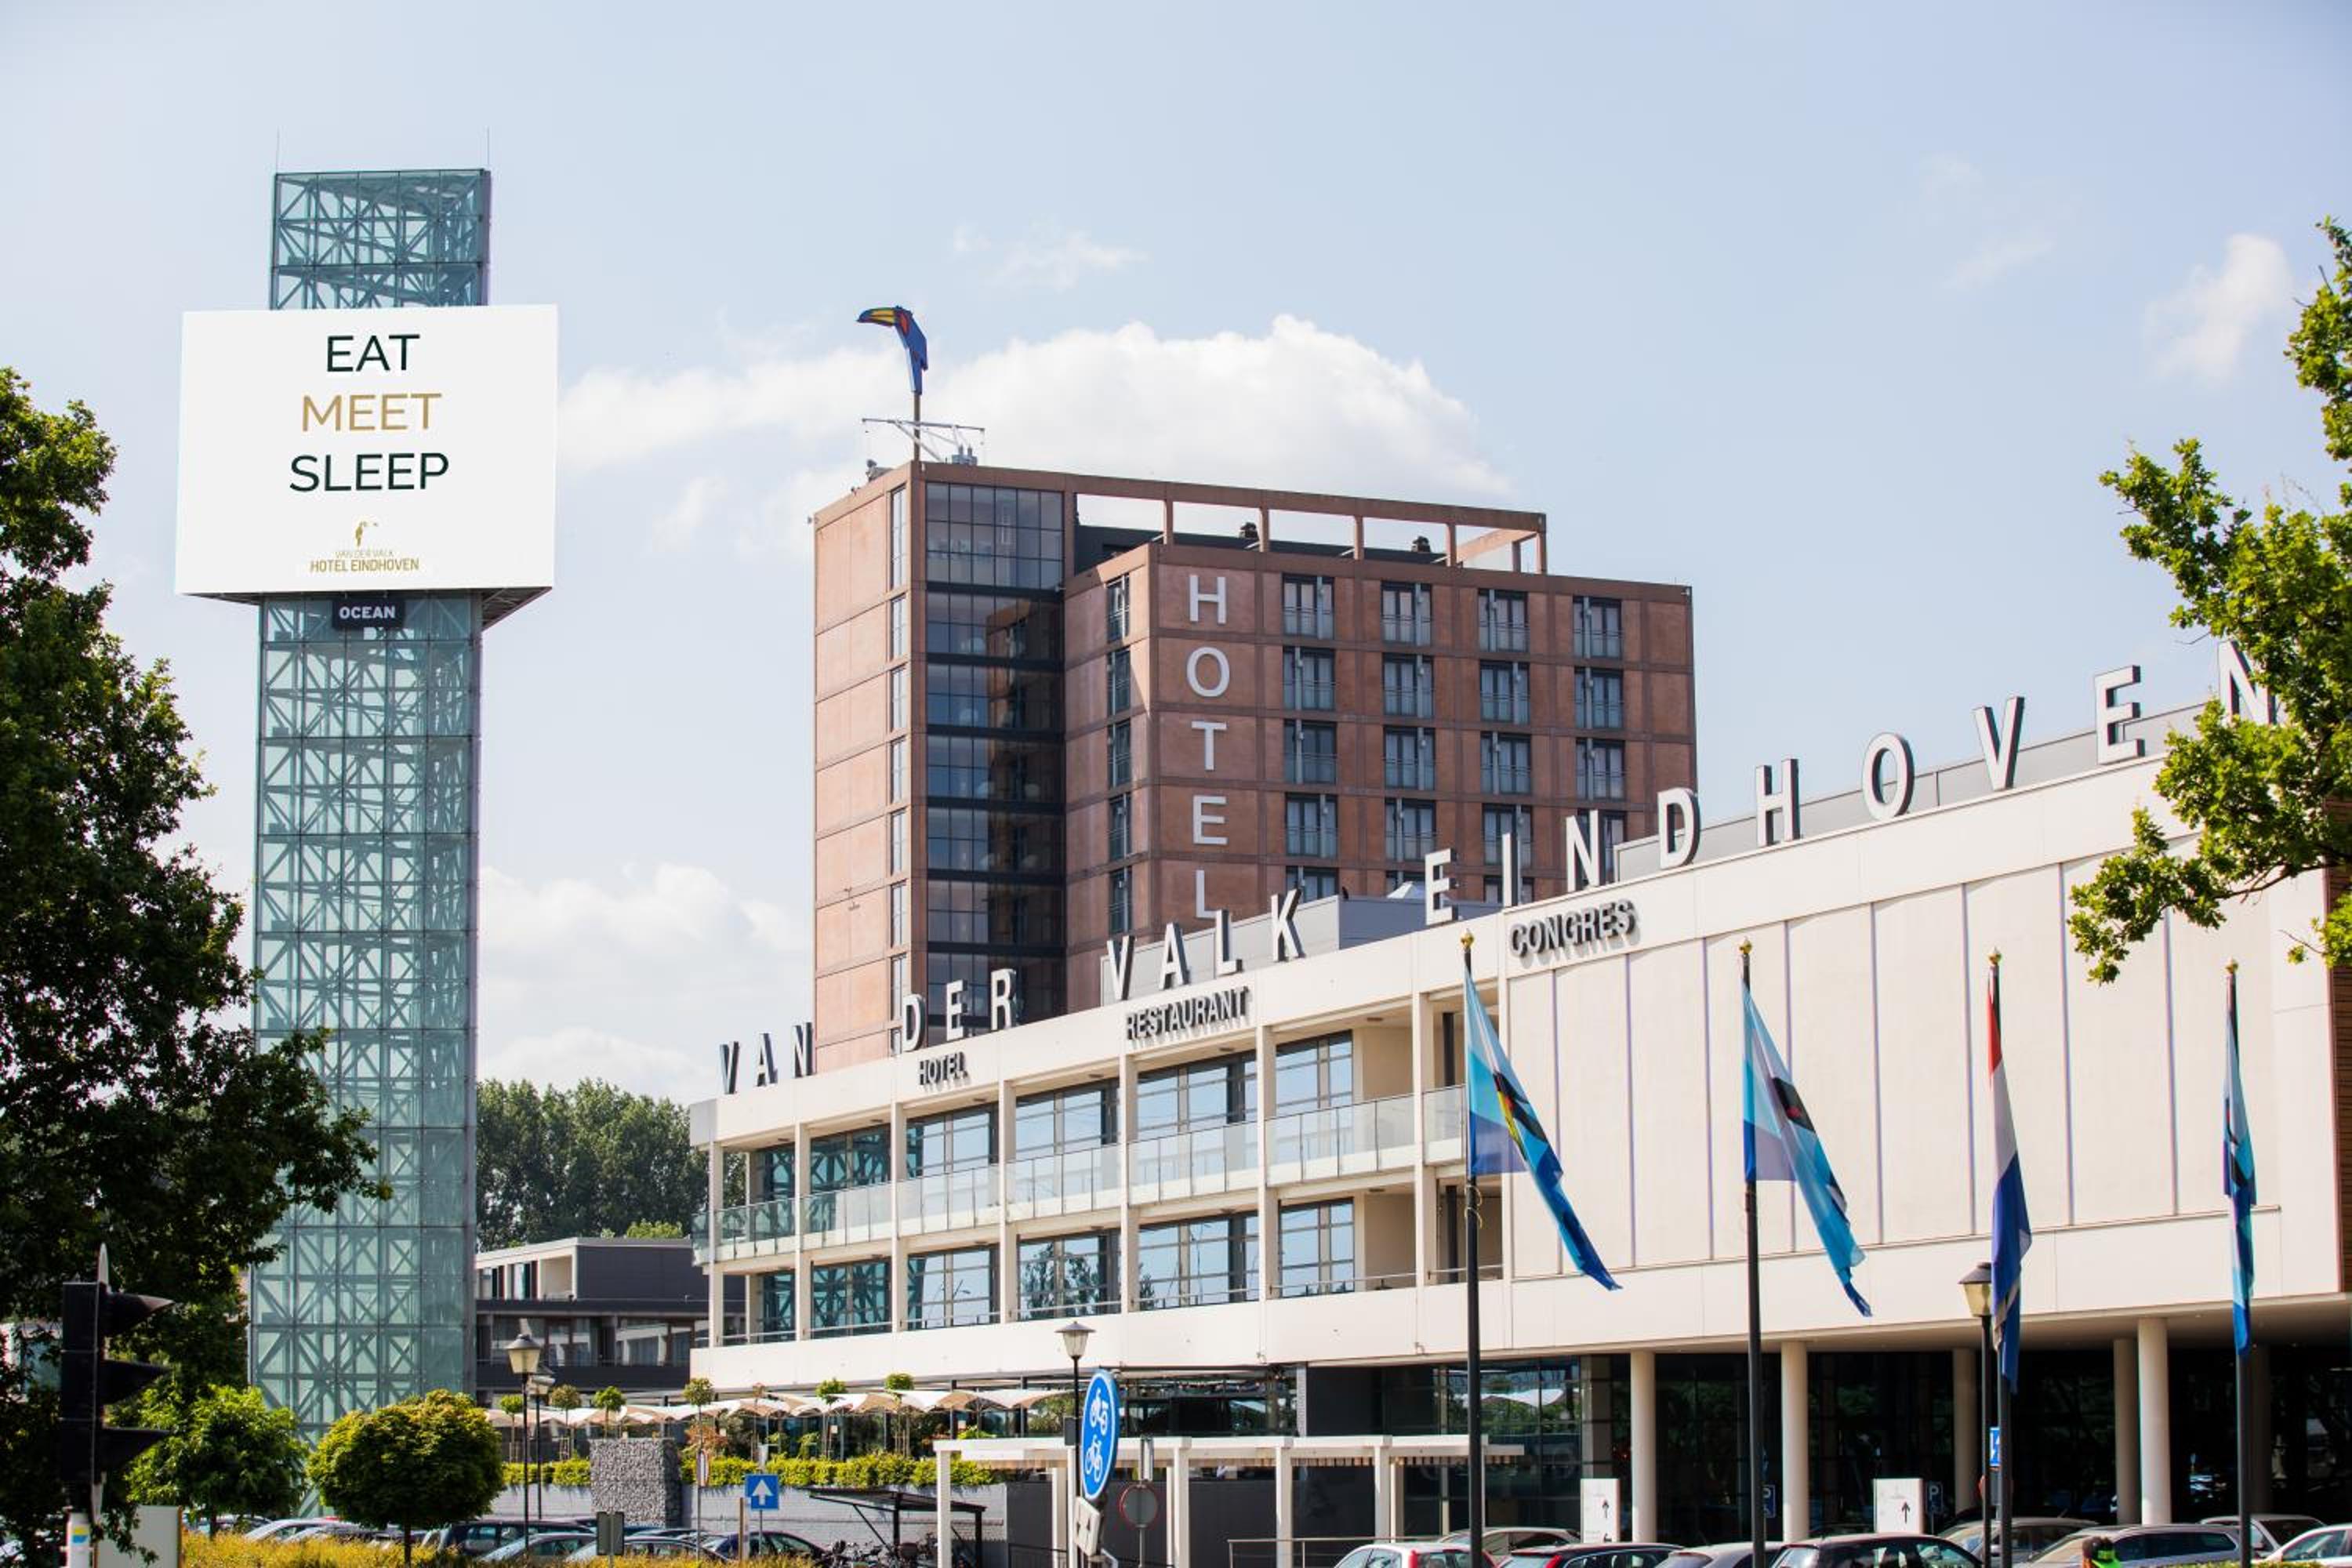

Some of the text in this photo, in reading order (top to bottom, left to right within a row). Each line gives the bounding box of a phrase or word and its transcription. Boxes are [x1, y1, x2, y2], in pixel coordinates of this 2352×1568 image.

[326, 333, 420, 373] EAT
[302, 392, 442, 433] MEET
[289, 452, 450, 493] SLEEP
[310, 557, 419, 573] HOTEL EINDHOVEN
[339, 605, 396, 619] OCEAN
[1186, 574, 1230, 920] HOTEL
[717, 638, 2278, 1095] VAN DER VALK EINDHOVEN
[1509, 898, 1637, 958] CONGRES
[1126, 985, 1249, 1040] RESTAURANT
[917, 1051, 968, 1087] HOTEL
[1929, 1485, 1940, 1501] P
